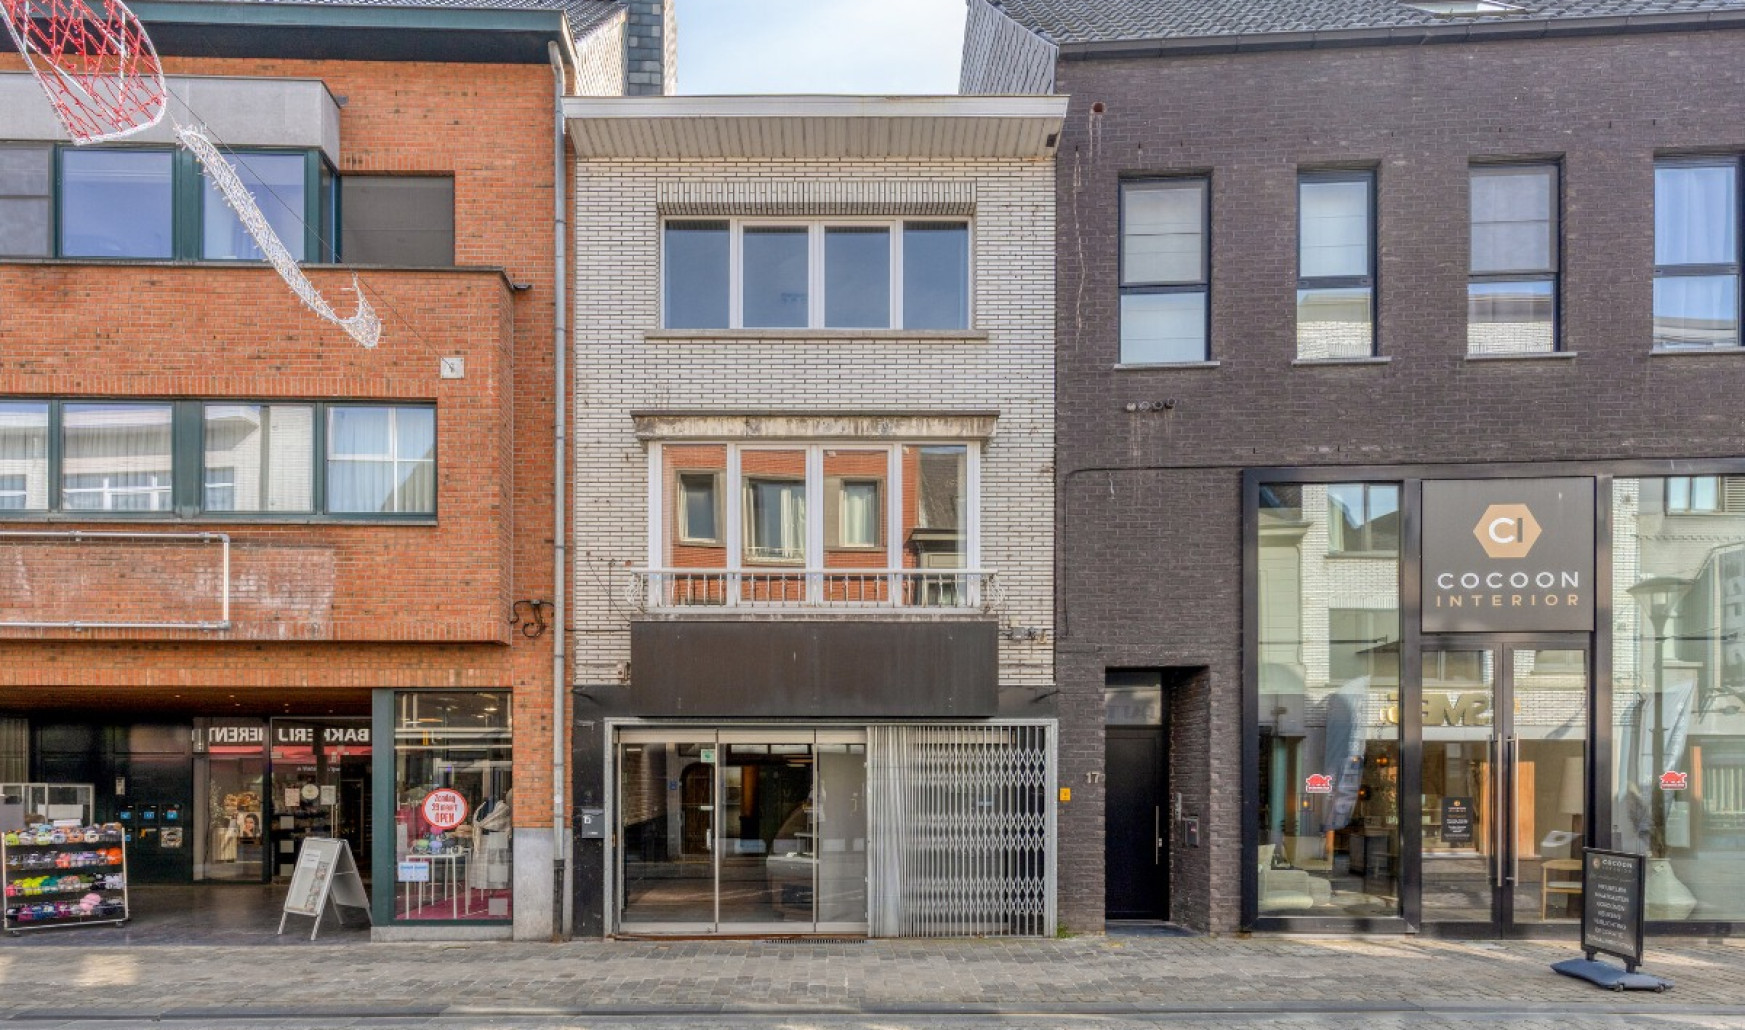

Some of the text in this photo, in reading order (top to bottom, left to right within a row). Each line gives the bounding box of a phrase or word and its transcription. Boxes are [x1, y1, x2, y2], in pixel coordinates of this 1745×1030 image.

[1437, 571, 1579, 590] COCOON
[1436, 594, 1579, 608] INTERIOR
[1086, 771, 1100, 784] 17
[434, 812, 455, 823] OPEN
[1602, 859, 1633, 869] COCOON
